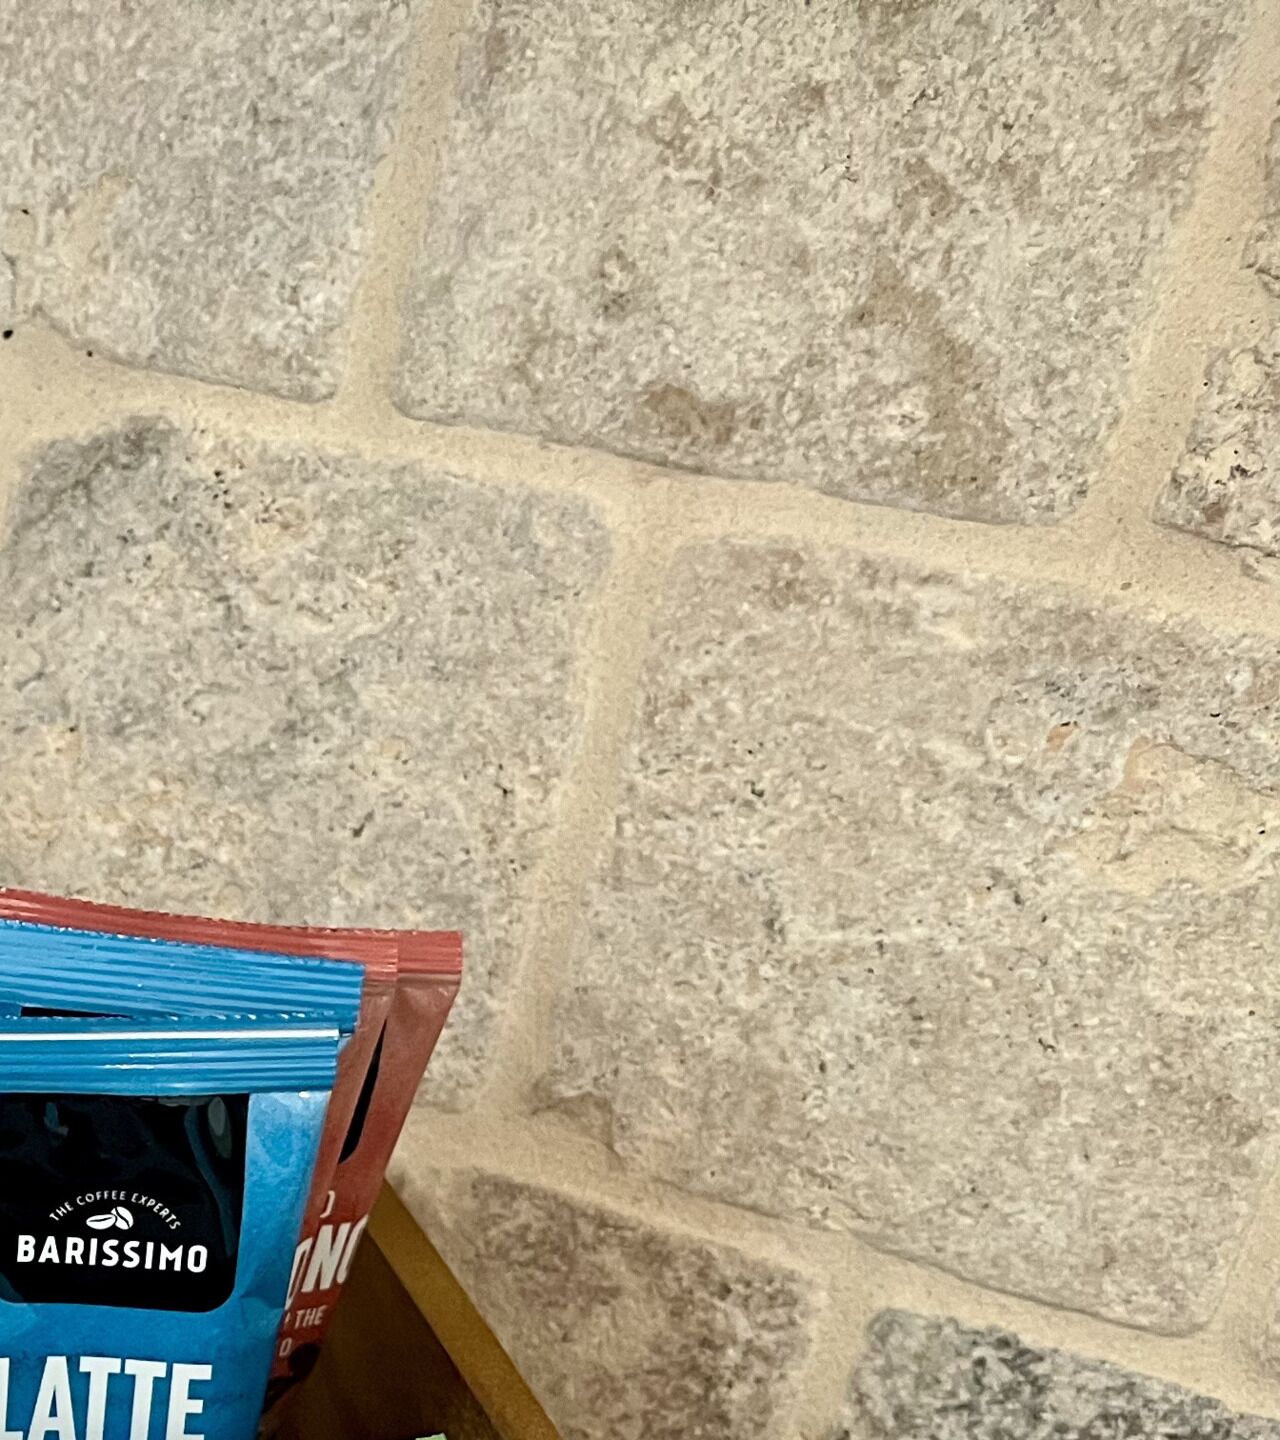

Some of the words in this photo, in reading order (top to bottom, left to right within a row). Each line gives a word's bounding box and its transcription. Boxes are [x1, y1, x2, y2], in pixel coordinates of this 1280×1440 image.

[49, 1200, 75, 1222] THE
[76, 1190, 126, 1206] COFFEE
[131, 1192, 181, 1230] EXPERTS
[16, 1234, 208, 1273] BARISSIMO
[295, 1304, 328, 1330] THE
